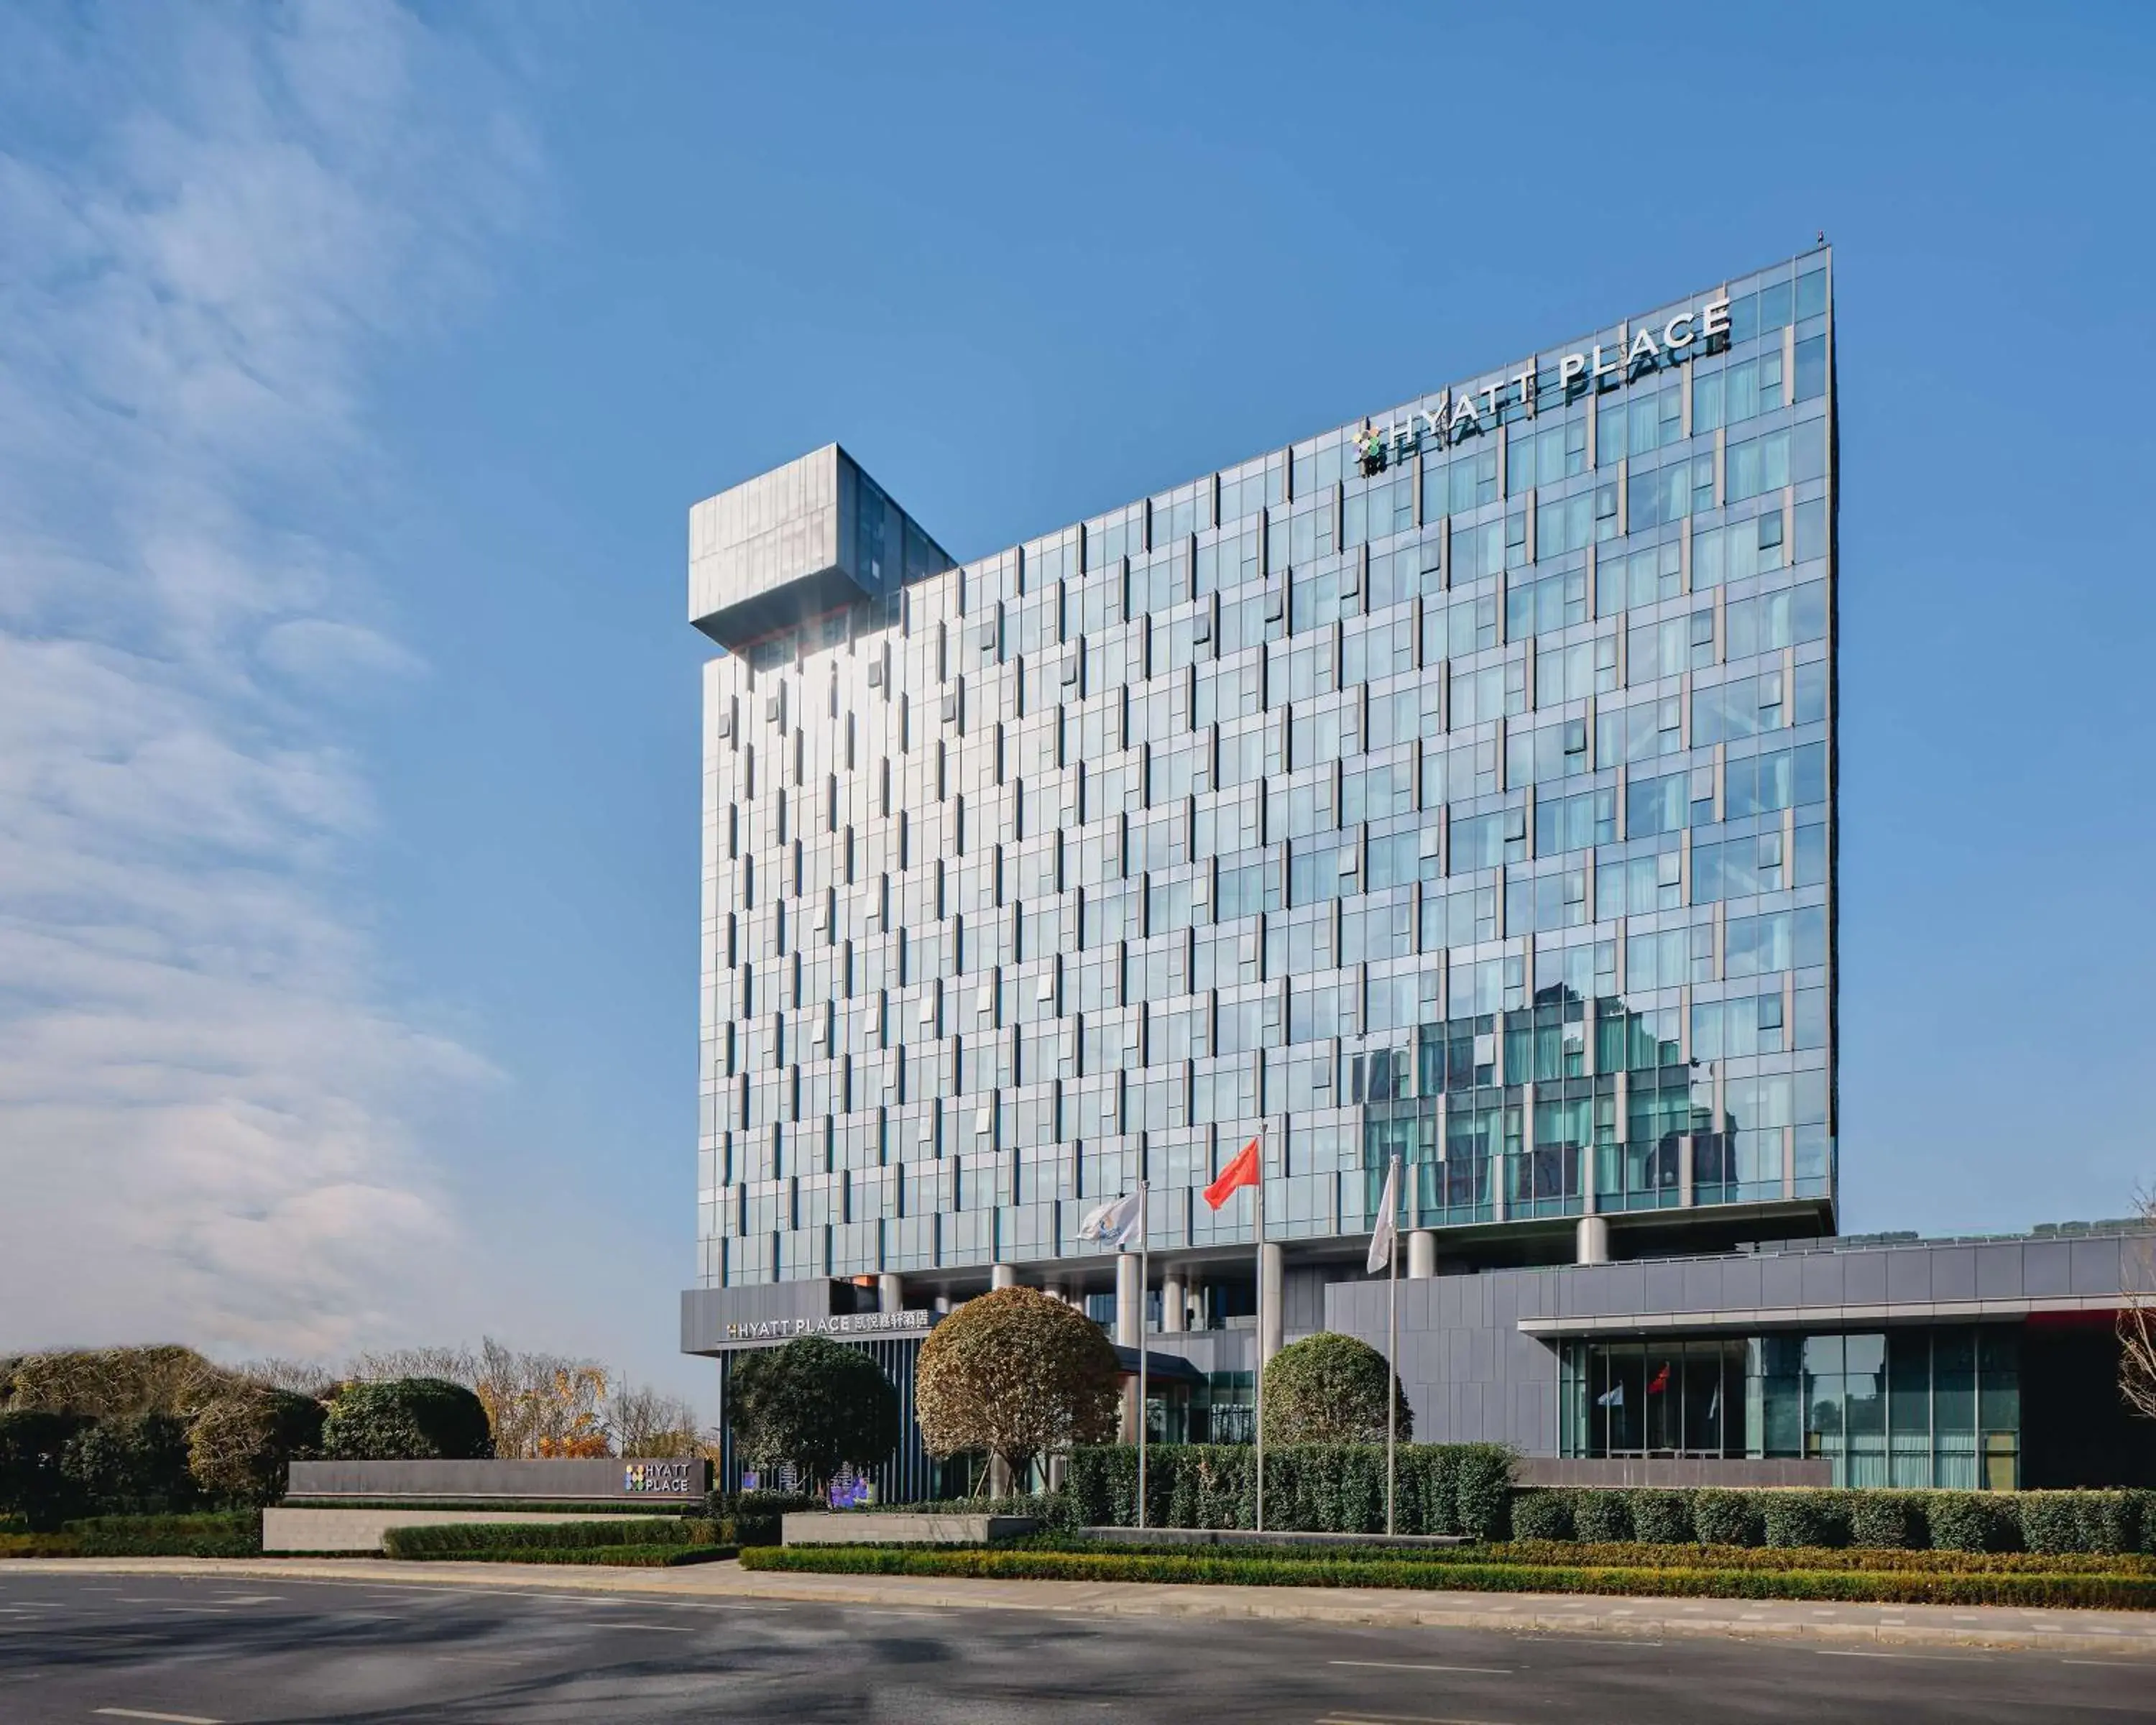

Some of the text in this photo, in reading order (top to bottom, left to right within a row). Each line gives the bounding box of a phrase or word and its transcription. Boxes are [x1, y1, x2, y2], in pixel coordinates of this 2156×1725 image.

[1388, 297, 1731, 448] HYATT PLACE
[739, 1320, 790, 1338] HYATT
[796, 1316, 849, 1333] PLACE
[646, 1463, 689, 1477] HYATT
[646, 1479, 688, 1492] PLACE
